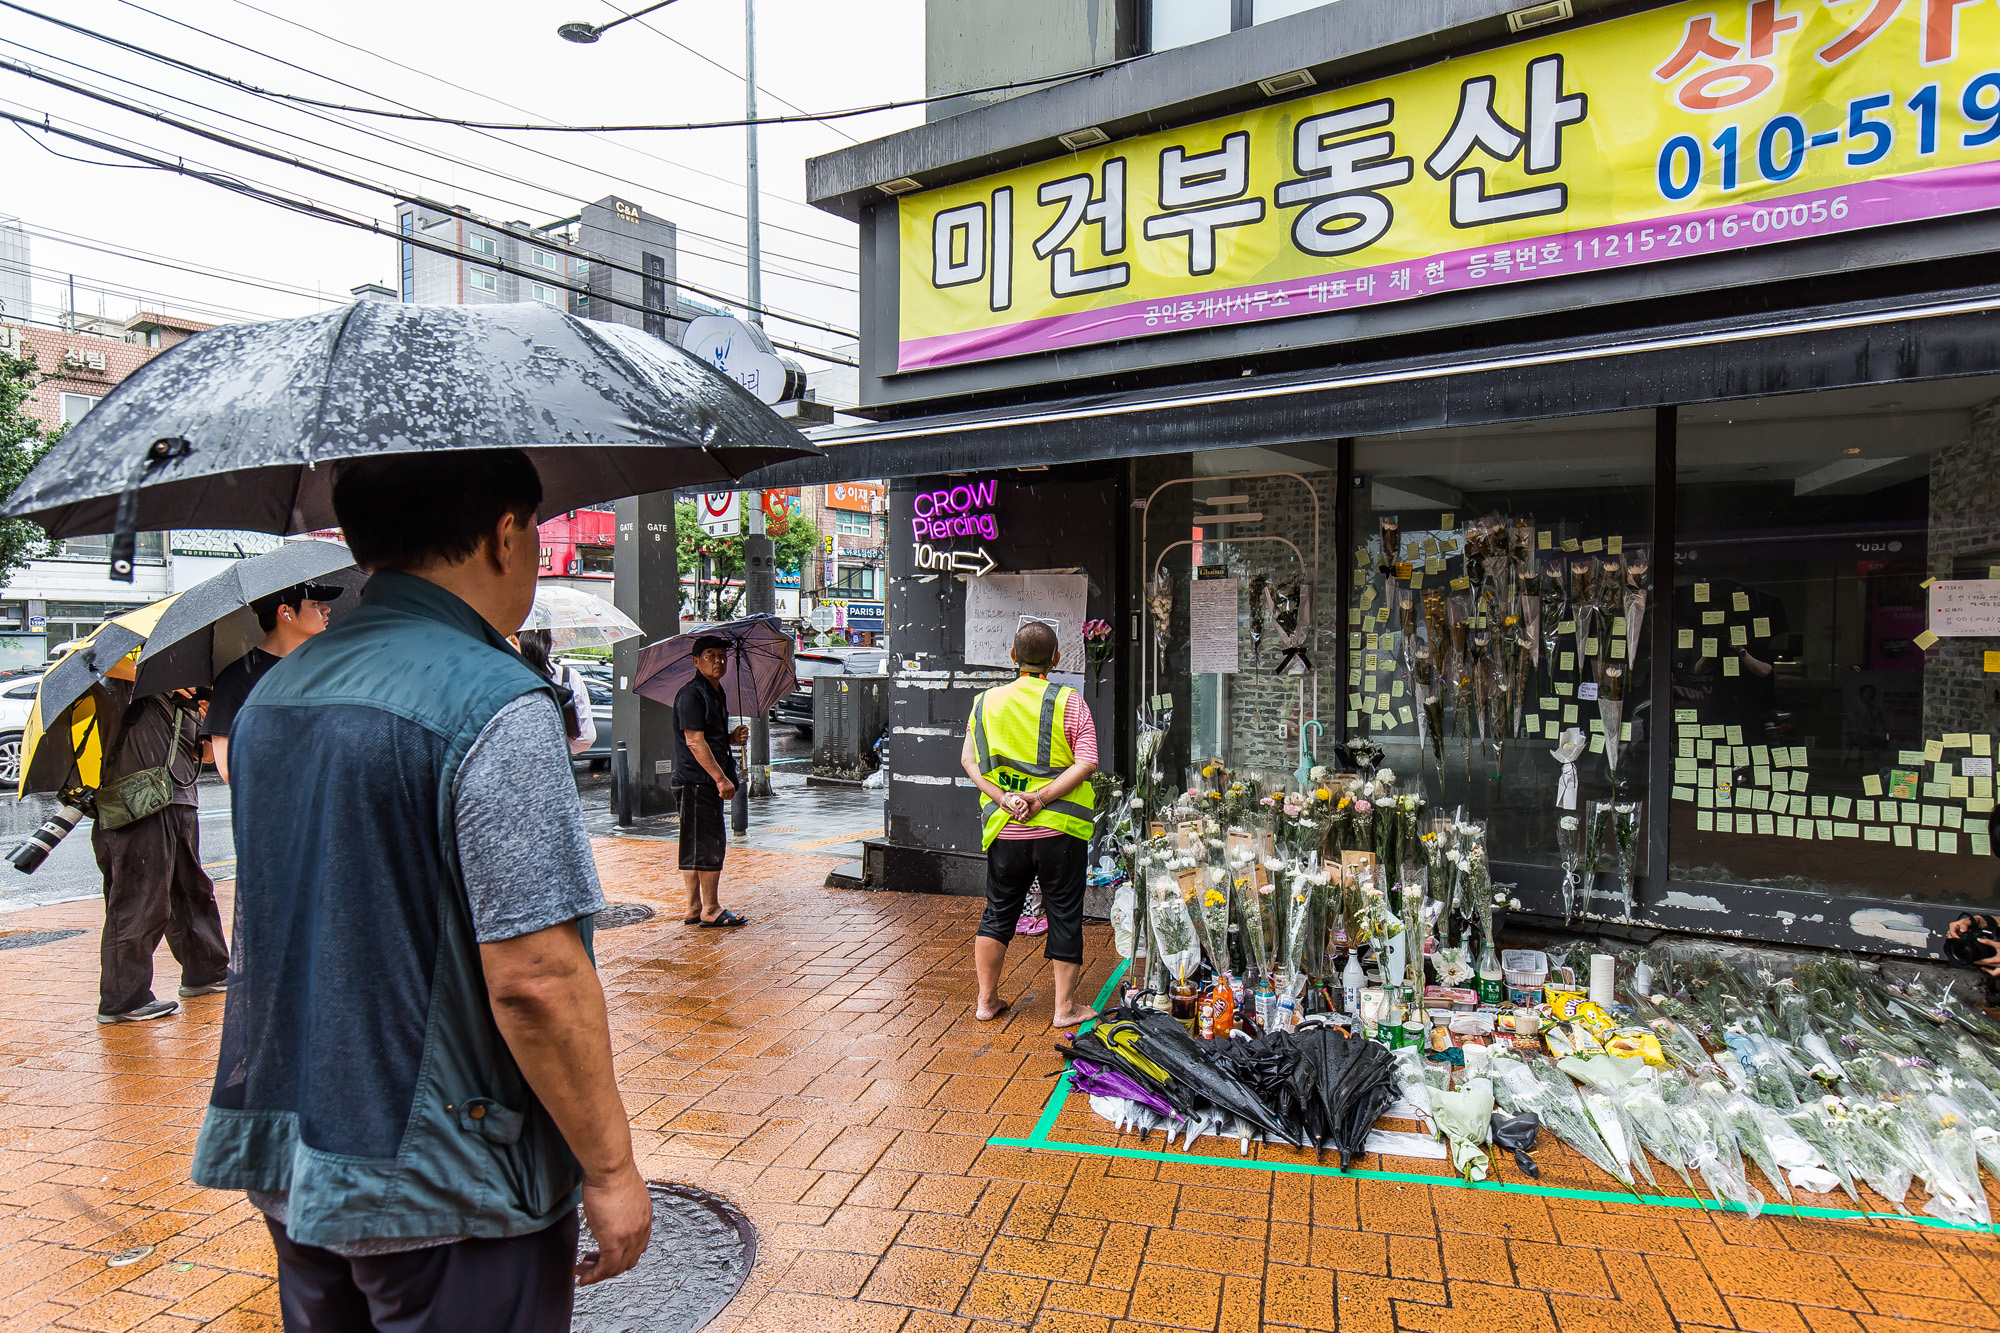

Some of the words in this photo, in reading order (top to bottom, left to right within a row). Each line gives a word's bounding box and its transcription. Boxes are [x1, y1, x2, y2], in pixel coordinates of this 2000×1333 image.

[932, 52, 1589, 313] 미건부동산
[615, 201, 639, 218] C&A
[1143, 288, 1290, 327] 공인중개사사무소
[1308, 279, 1348, 304] 대표
[1466, 242, 1564, 280] 등록번호
[1573, 195, 1850, 262] 11215-2016-00056
[64, 348, 106, 371] 신림
[913, 479, 998, 518] CROW
[619, 523, 633, 532] GATE
[647, 523, 668, 532] GATE
[911, 511, 999, 542] Piercing
[624, 533, 629, 541] B
[912, 542, 953, 571] 10m
[1199, 568, 1225, 576] Ghana
[849, 608, 874, 616] PARIS
